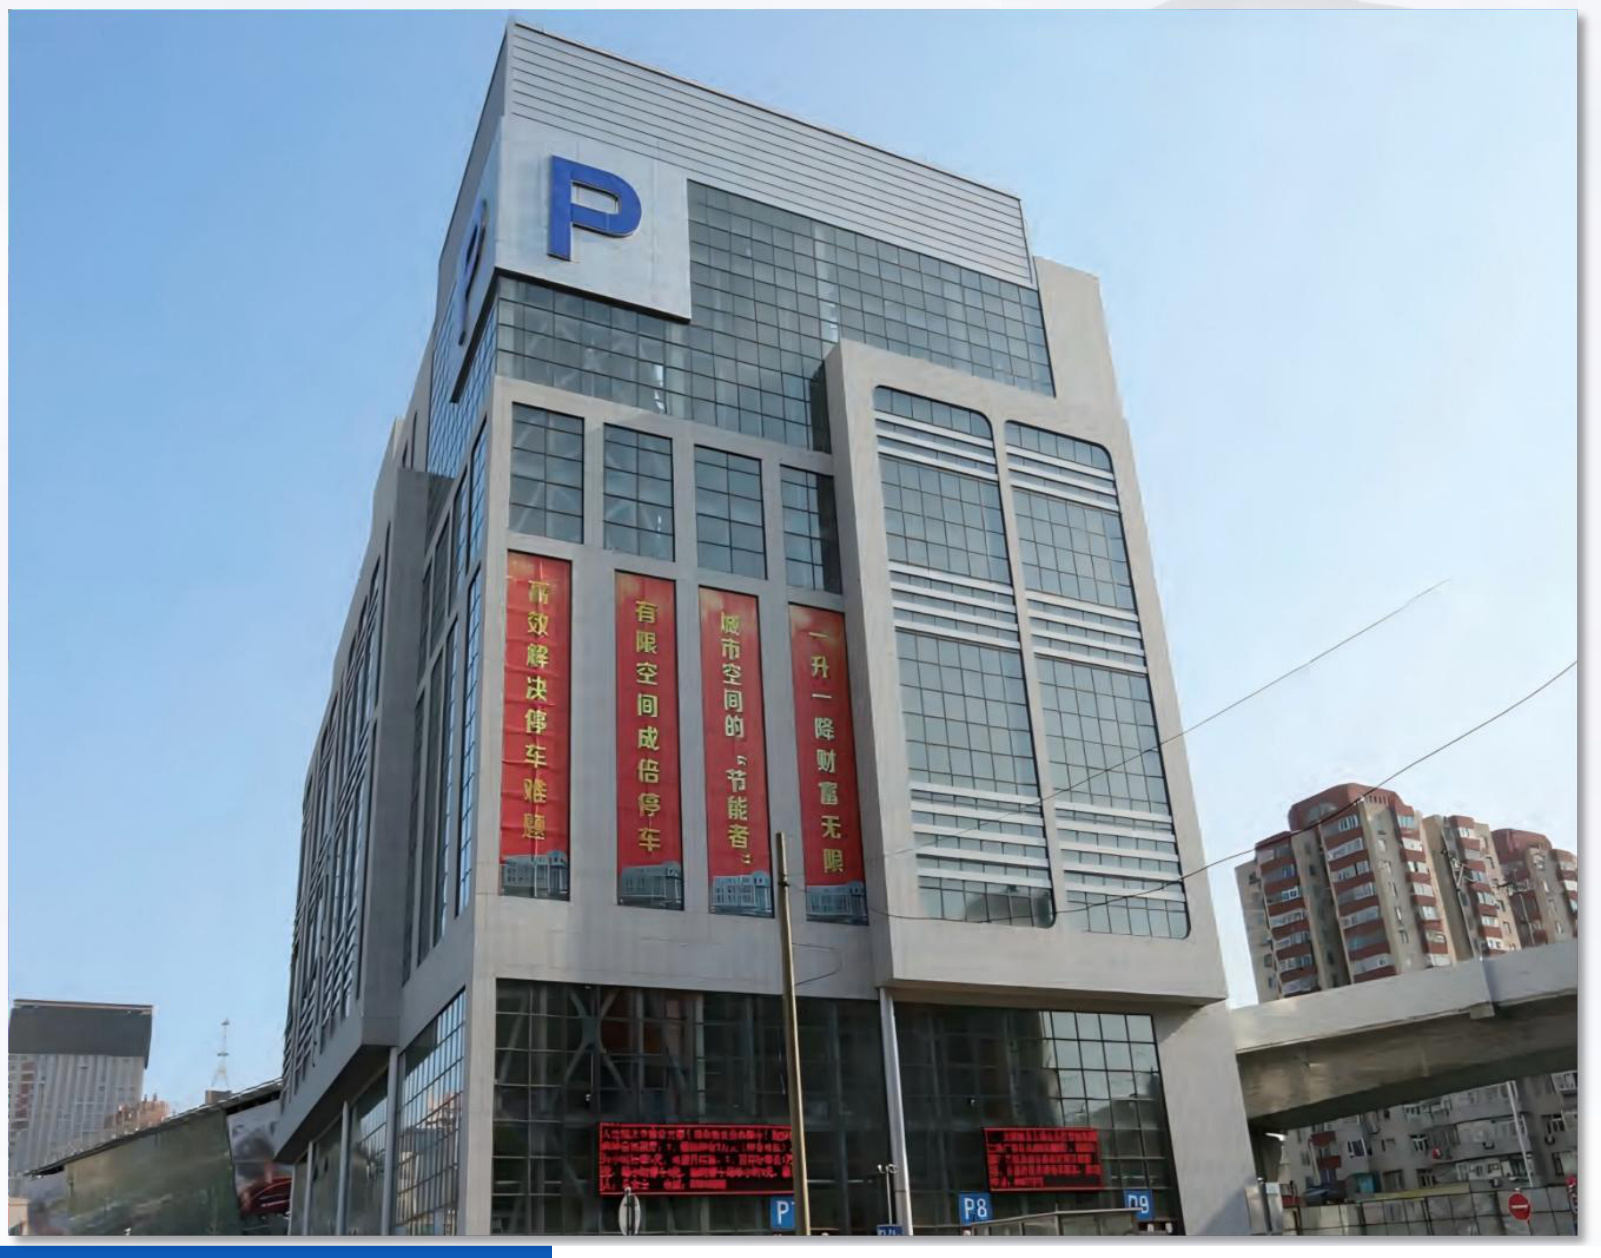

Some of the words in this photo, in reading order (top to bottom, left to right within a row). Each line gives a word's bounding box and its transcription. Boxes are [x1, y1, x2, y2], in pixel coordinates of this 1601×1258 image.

[547, 155, 642, 261] P
[635, 600, 660, 851] 有限空间成倍停车
[808, 631, 844, 873] 一升一降财富无限
[777, 1200, 794, 1224] P
[964, 1197, 988, 1220] P8
